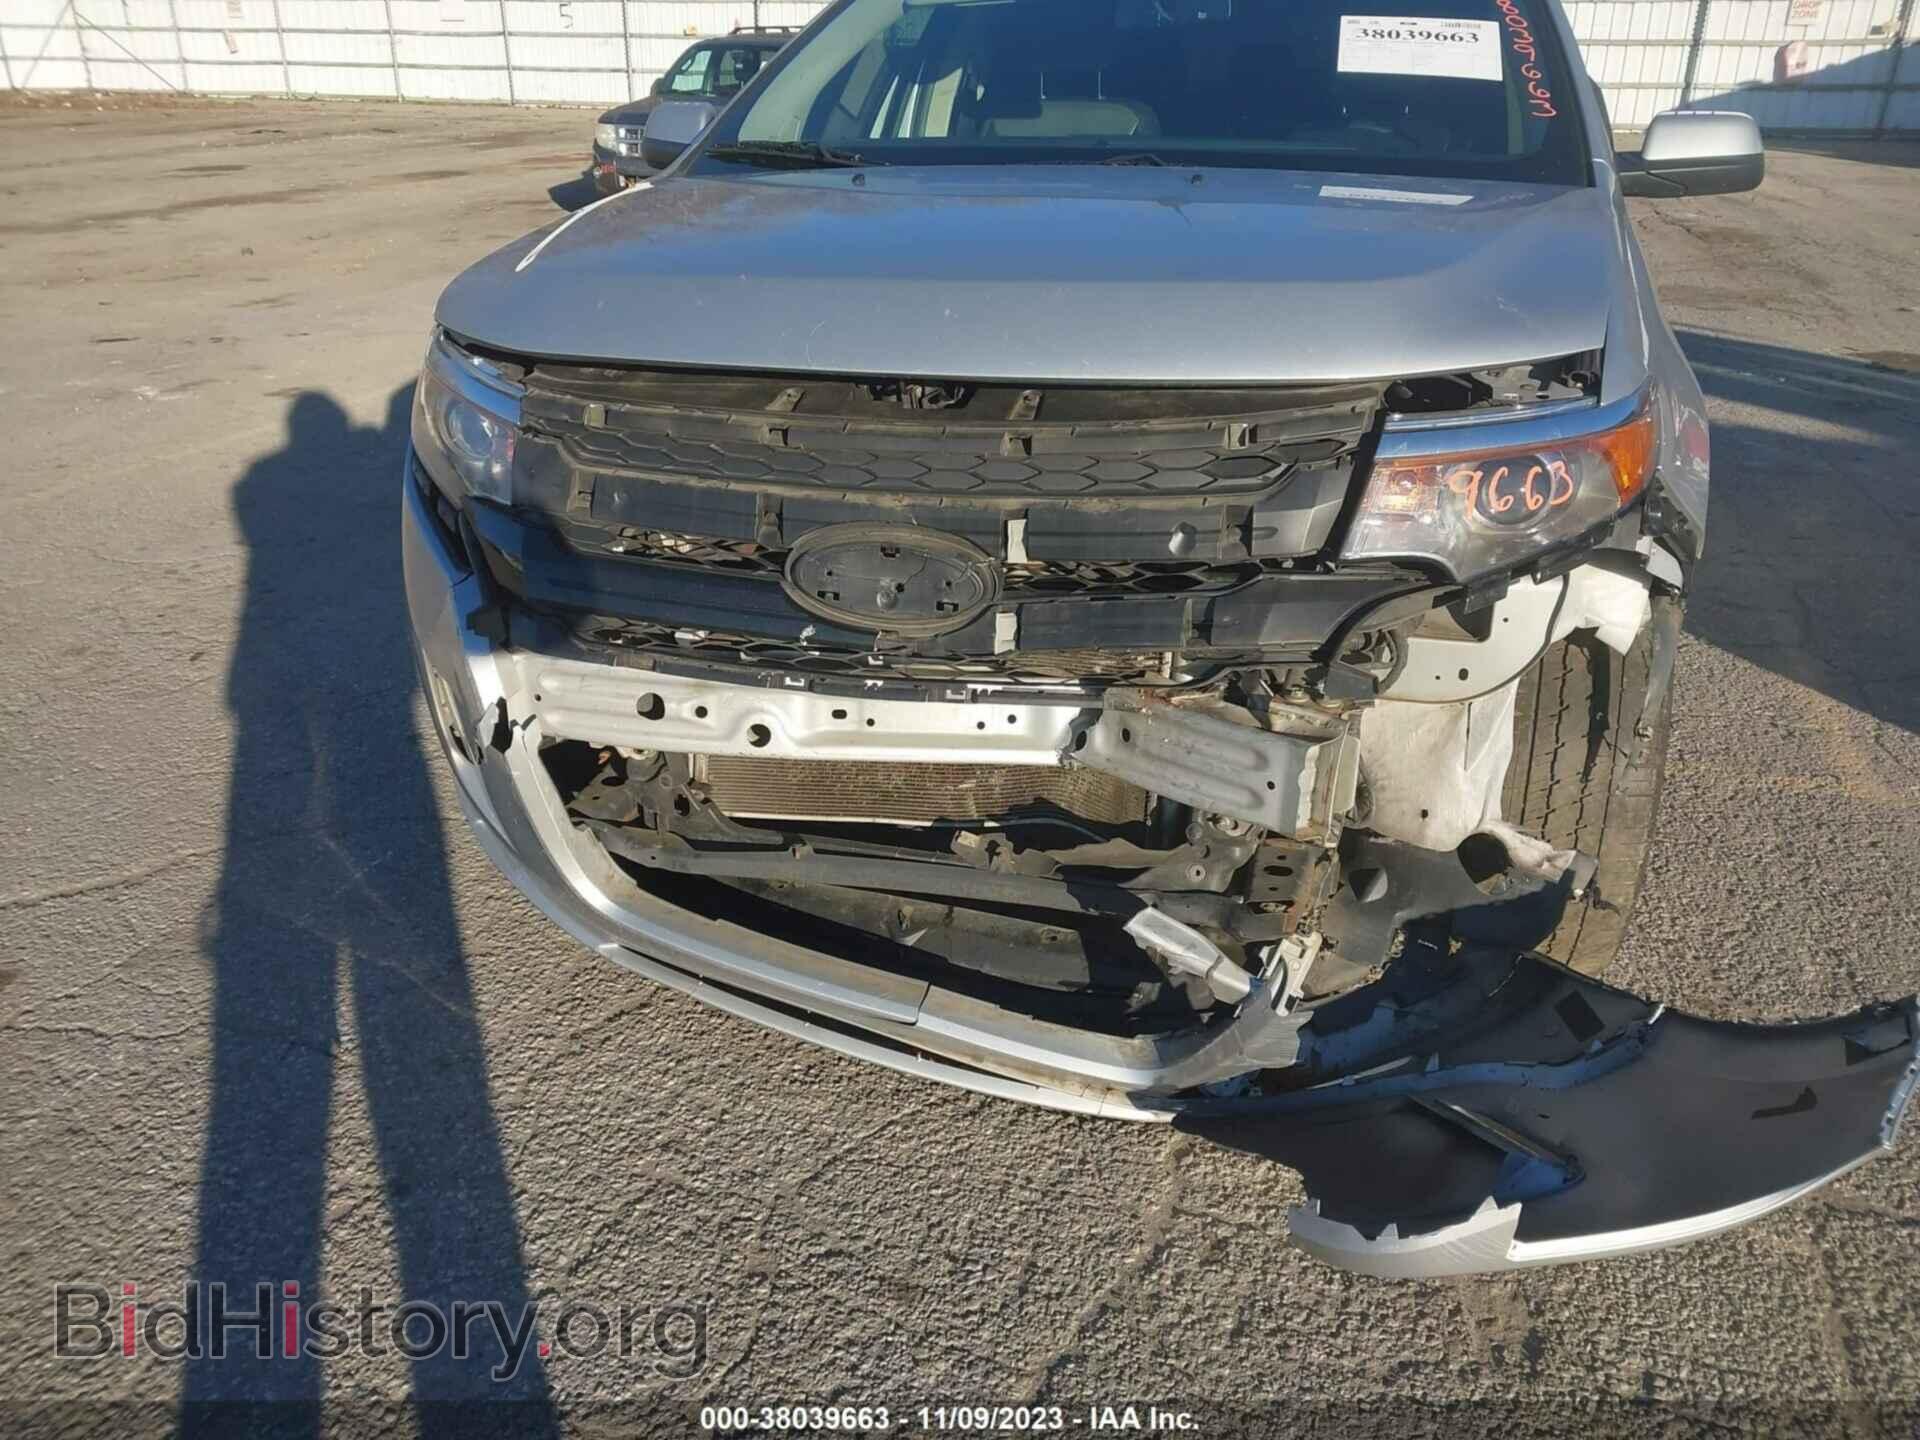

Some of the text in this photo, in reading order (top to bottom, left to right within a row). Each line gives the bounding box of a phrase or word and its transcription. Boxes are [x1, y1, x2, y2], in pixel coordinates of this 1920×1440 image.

[559, 2, 574, 29] 5
[1355, 28, 1480, 43] 38039663
[1446, 460, 1574, 522] 9663
